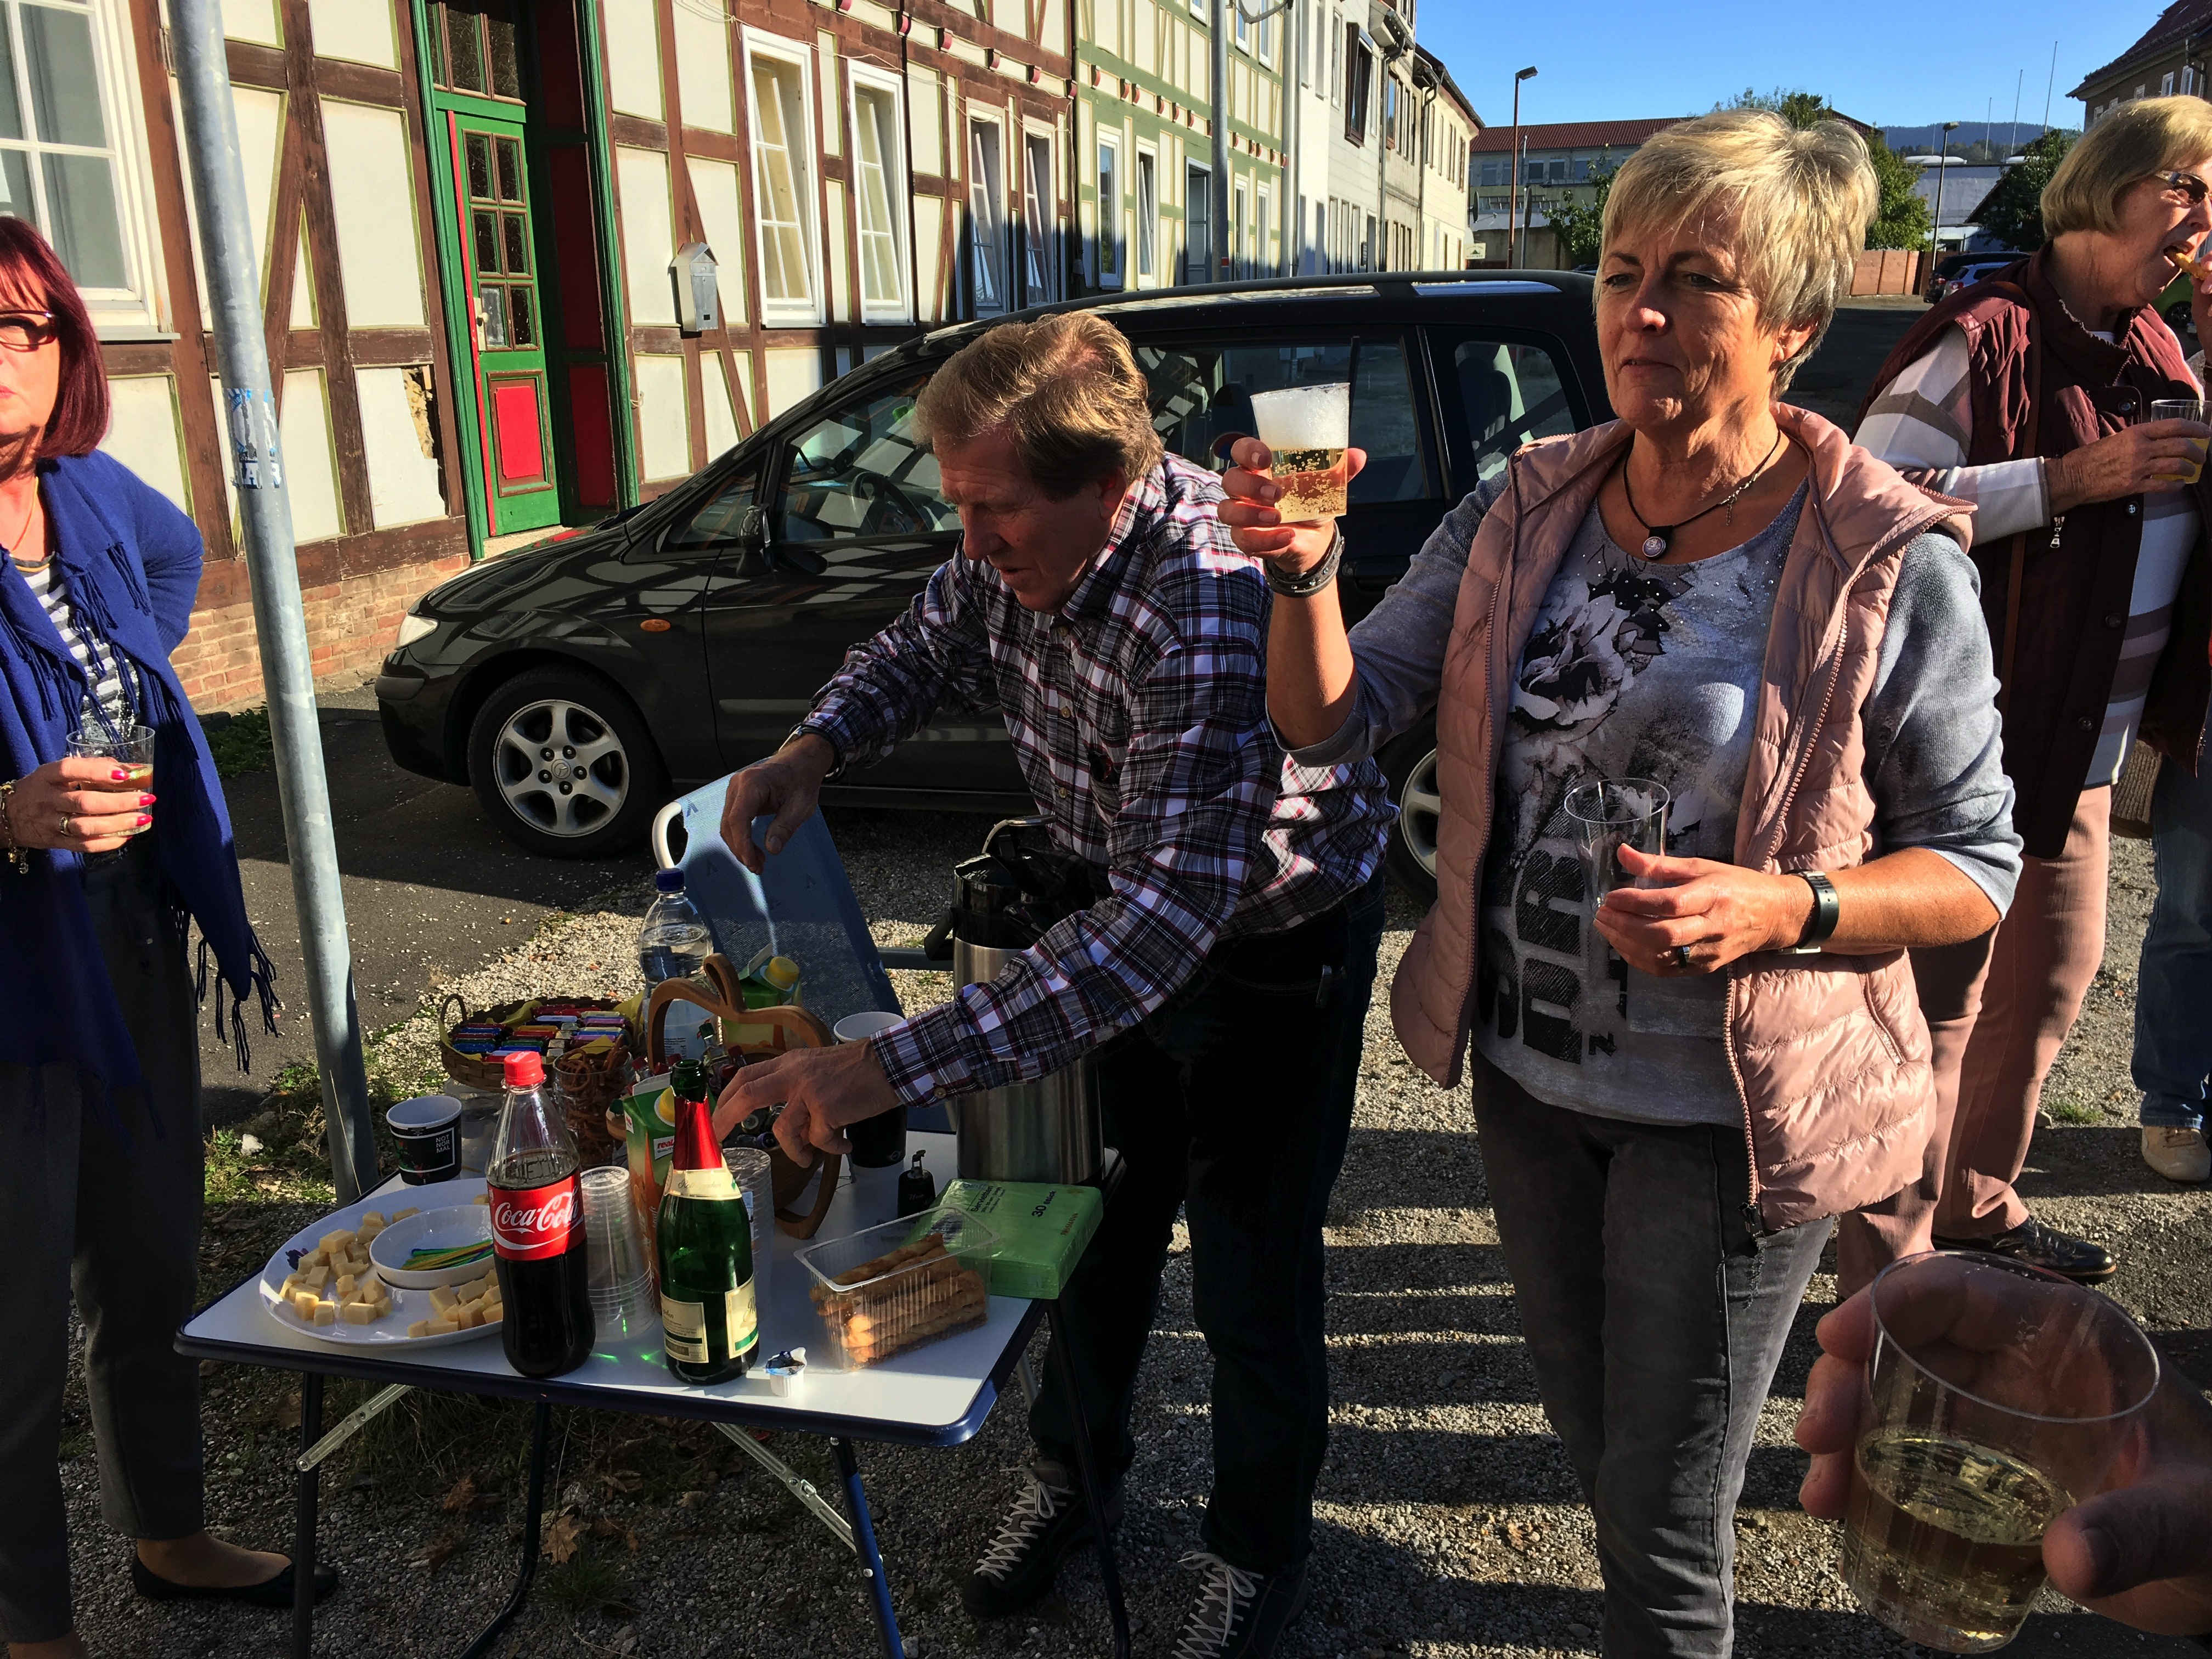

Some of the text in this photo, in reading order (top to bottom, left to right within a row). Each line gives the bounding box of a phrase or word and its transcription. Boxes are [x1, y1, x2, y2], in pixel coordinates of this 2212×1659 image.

[436, 1134, 450, 1143] NOT
[436, 1141, 450, 1149] NOR
[436, 1146, 451, 1154] MAL
[970, 1185, 994, 1212] Servietten
[494, 1185, 579, 1234] Coca-Cola
[1031, 1205, 1047, 1217] 30
